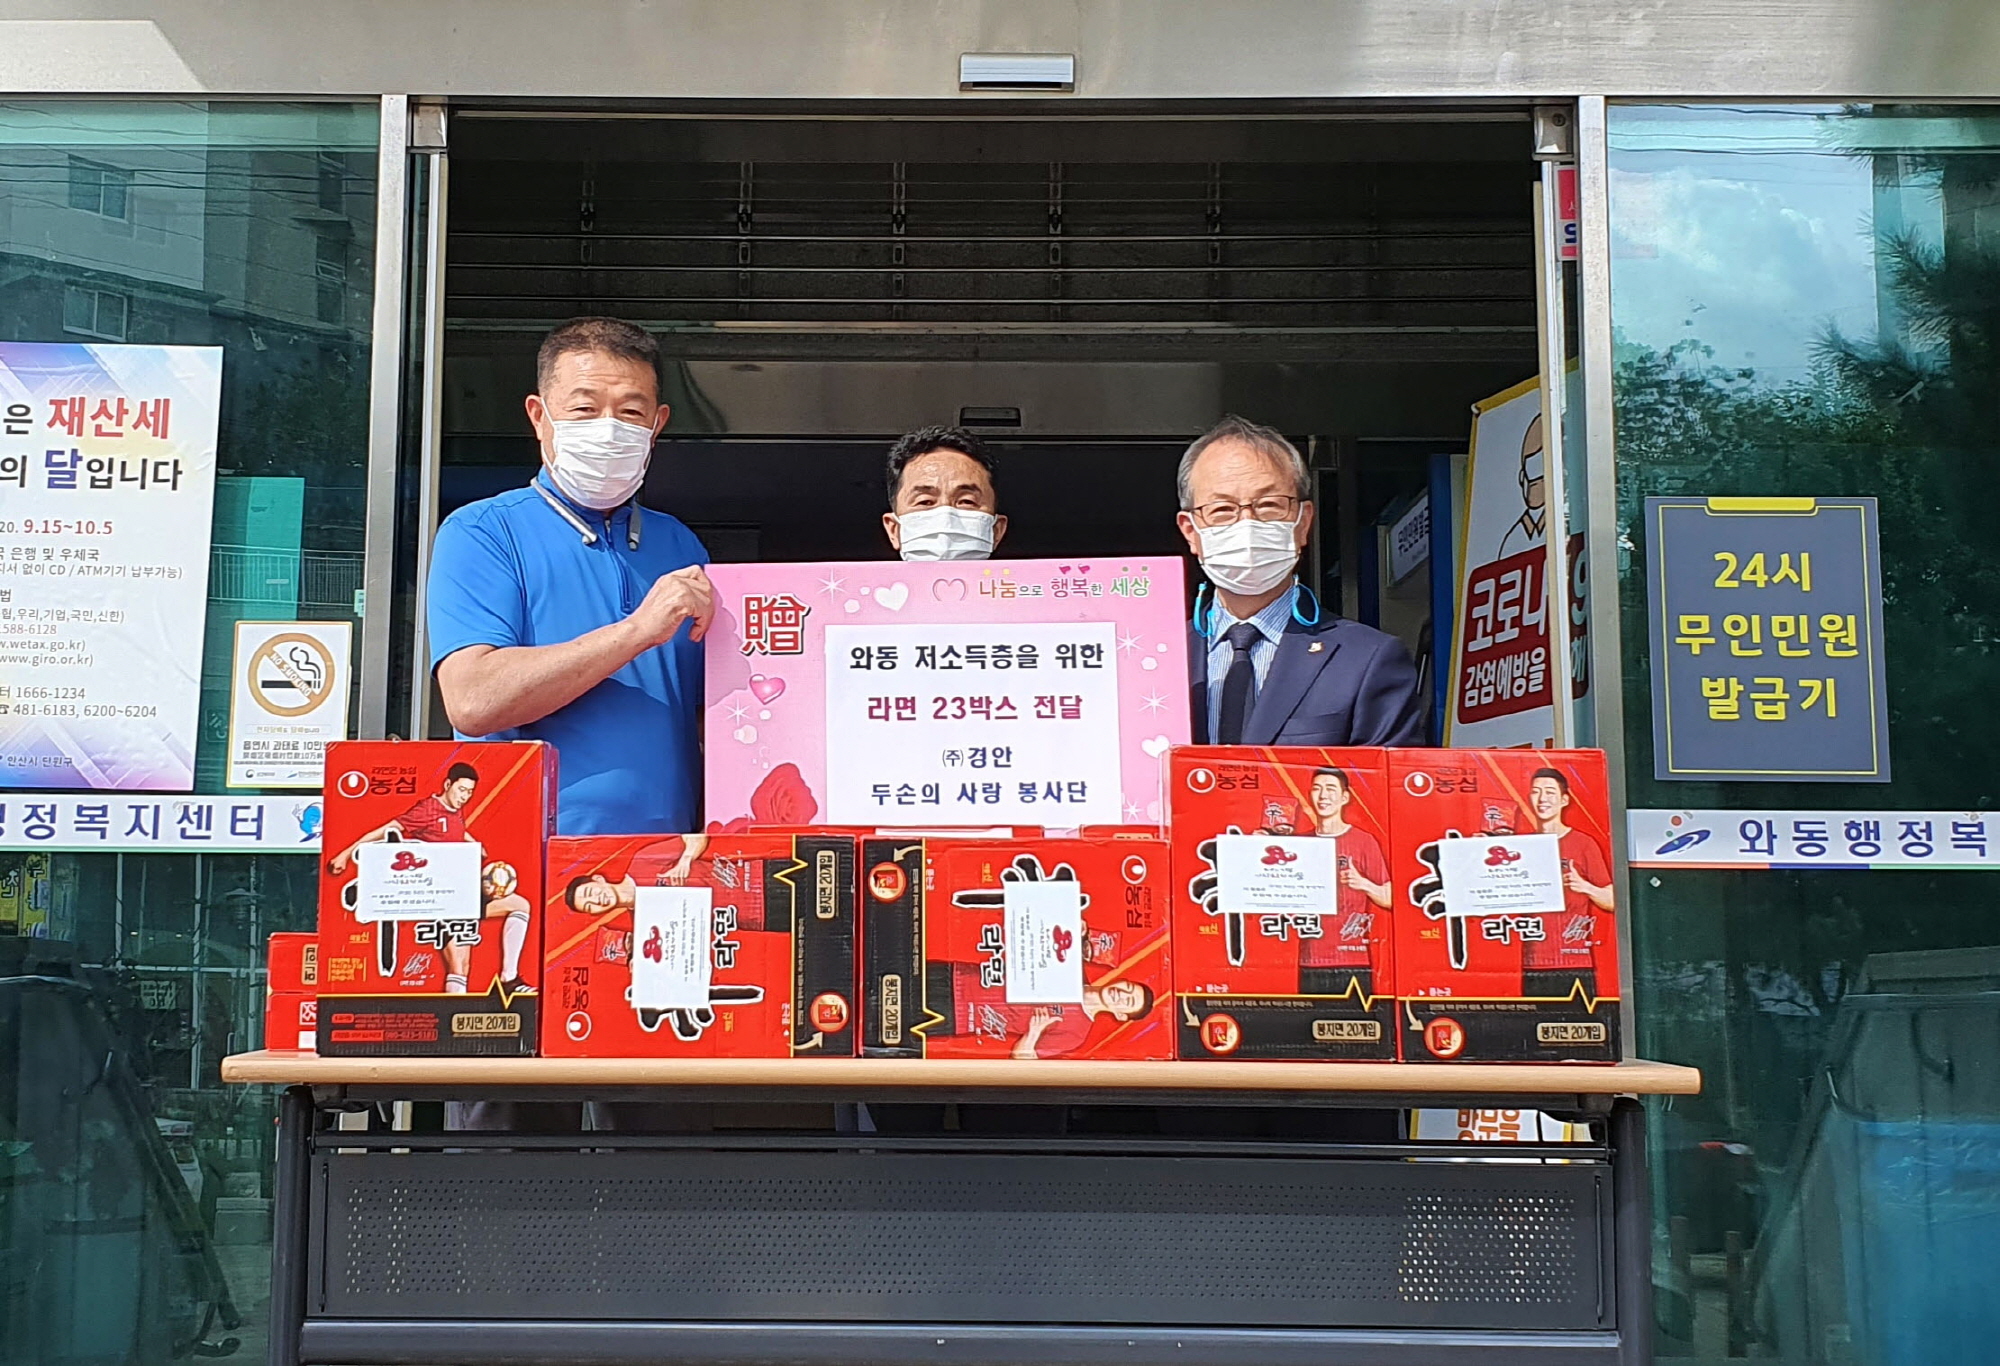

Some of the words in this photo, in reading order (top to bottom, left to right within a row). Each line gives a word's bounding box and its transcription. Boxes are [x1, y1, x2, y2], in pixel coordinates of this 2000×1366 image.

[47, 396, 171, 439] 재산세
[44, 448, 183, 491] 달입니다
[23, 519, 113, 535] 9.15~10.5
[10, 547, 37, 561] 은행
[42, 547, 55, 561] 및
[59, 548, 100, 562] 우체국
[22, 562, 45, 576] 없이
[49, 564, 66, 575] CD
[77, 564, 127, 578] ATM기기
[131, 565, 183, 579] 납부가능)
[1713, 552, 1811, 592] 24시
[979, 577, 1044, 599] 나눔으로
[1050, 576, 1103, 598] 행복한
[1110, 576, 1150, 597] 세상
[741, 593, 810, 655] 贈
[1675, 613, 1860, 658] 무인민원
[269, 652, 283, 666] NO
[850, 645, 899, 670] 와동
[915, 643, 1039, 670] 저소득층을
[1055, 642, 1104, 669] 위한
[1465, 646, 1546, 708] 감염예방을
[16, 686, 86, 700] 1666-1234
[1701, 677, 1837, 720] 발급기
[13, 703, 80, 718] 481-6183,
[83, 704, 157, 718] 6200~6204
[868, 696, 917, 721] 라면
[932, 696, 1018, 721] 23박스
[1034, 694, 1083, 720] 전달
[7, 755, 38, 768] 안산시
[42, 756, 73, 768] 단원구
[369, 776, 417, 796] 농심
[871, 782, 940, 805] 두손의
[956, 781, 1002, 805] 사랑
[1018, 780, 1088, 803] 봉사단
[1216, 773, 1259, 790] 농심
[1435, 777, 1478, 793] 농심
[1738, 819, 1988, 858] 와동행정복
[819, 854, 833, 884] 20개입
[819, 886, 833, 914] 봉지면
[1125, 886, 1143, 929] 농심
[416, 920, 479, 949] 라면
[715, 906, 738, 968] 라면
[1261, 914, 1322, 939] 라면
[1482, 916, 1545, 943] 라면
[980, 925, 1003, 987] 라면
[571, 966, 589, 1010] 농심
[885, 978, 898, 1005] 봉지면
[456, 1015, 483, 1031] 봉지면
[487, 1015, 516, 1031] 20개입
[885, 1008, 898, 1040] 20개입
[1316, 1023, 1343, 1037] 봉지면
[1347, 1022, 1376, 1038] 20개입
[1541, 1025, 1569, 1040] 봉지면
[1571, 1025, 1601, 1040] 20개입
